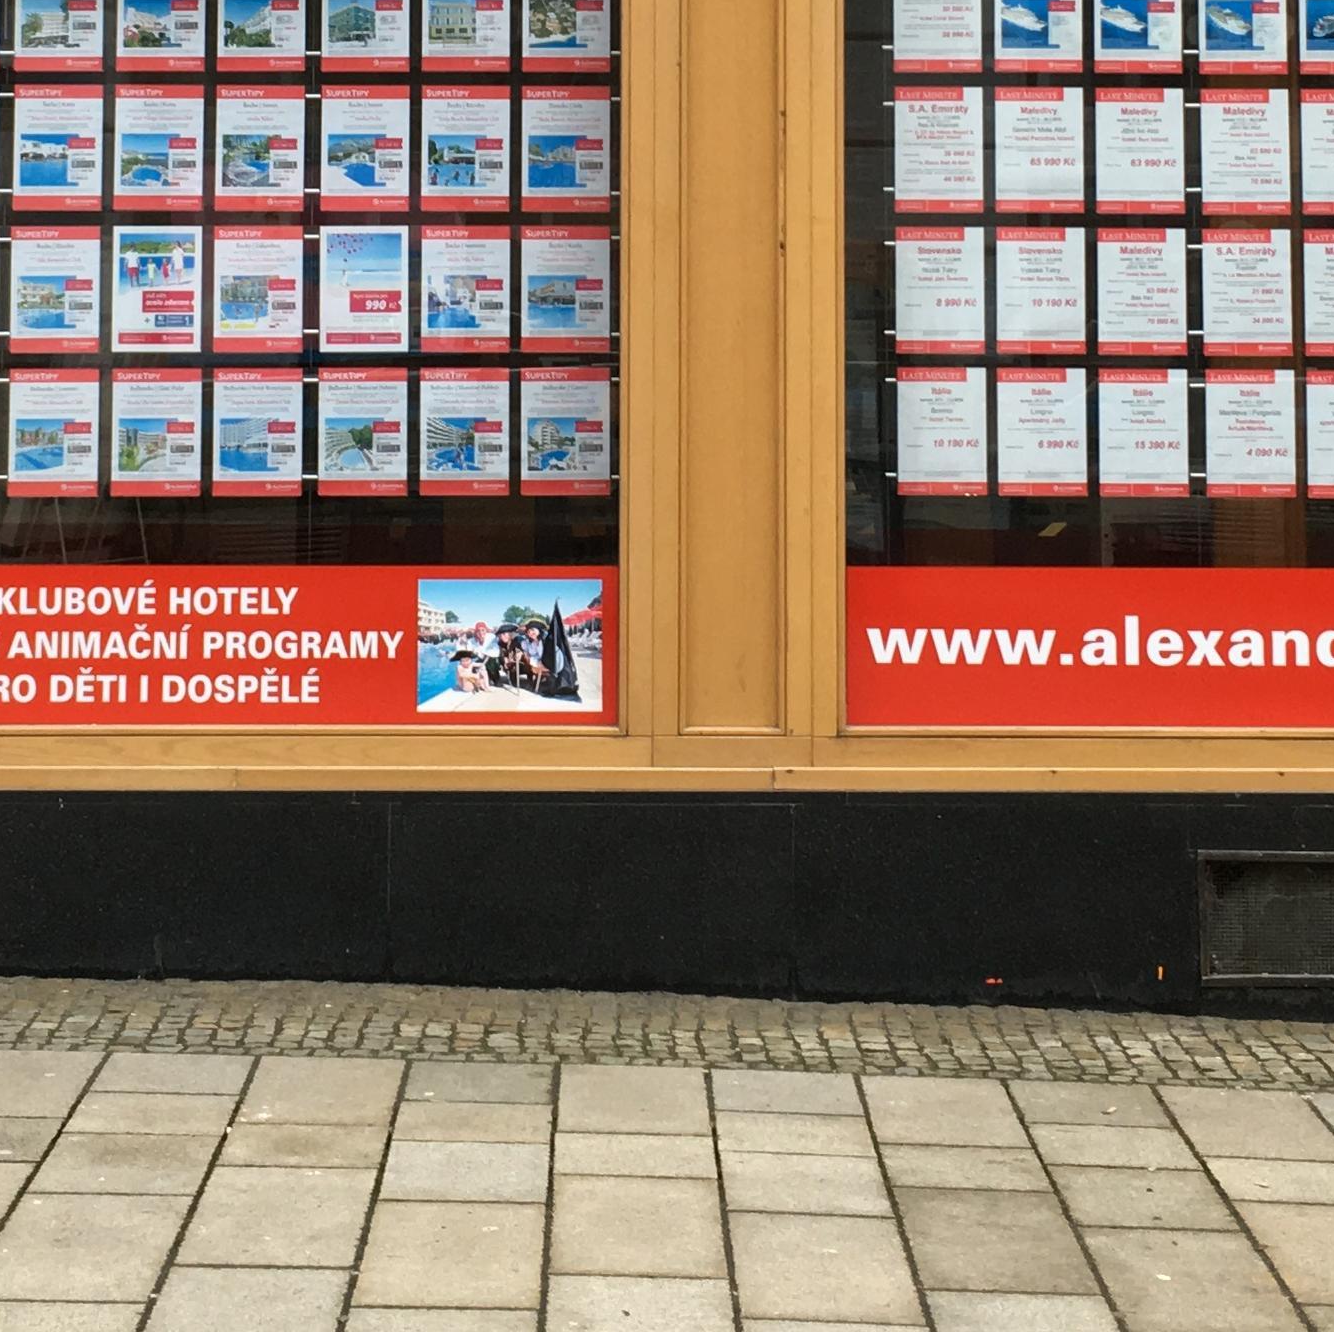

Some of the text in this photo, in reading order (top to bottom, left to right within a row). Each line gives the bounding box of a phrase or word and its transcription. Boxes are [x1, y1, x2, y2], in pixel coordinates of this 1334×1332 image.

[1020, 107, 1057, 115] Maledivy
[1121, 108, 1157, 116] Maledivy
[1223, 107, 1266, 117] Maledivy
[1120, 246, 1162, 256] Maledivy
[169, 587, 298, 615] HOTELY
[8, 624, 191, 659] ANIMAČNÍ
[203, 631, 403, 659] PROGRAMY
[50, 667, 126, 702] DĚTI
[140, 675, 148, 702] I
[162, 668, 319, 703] DOSPĚLÉ
